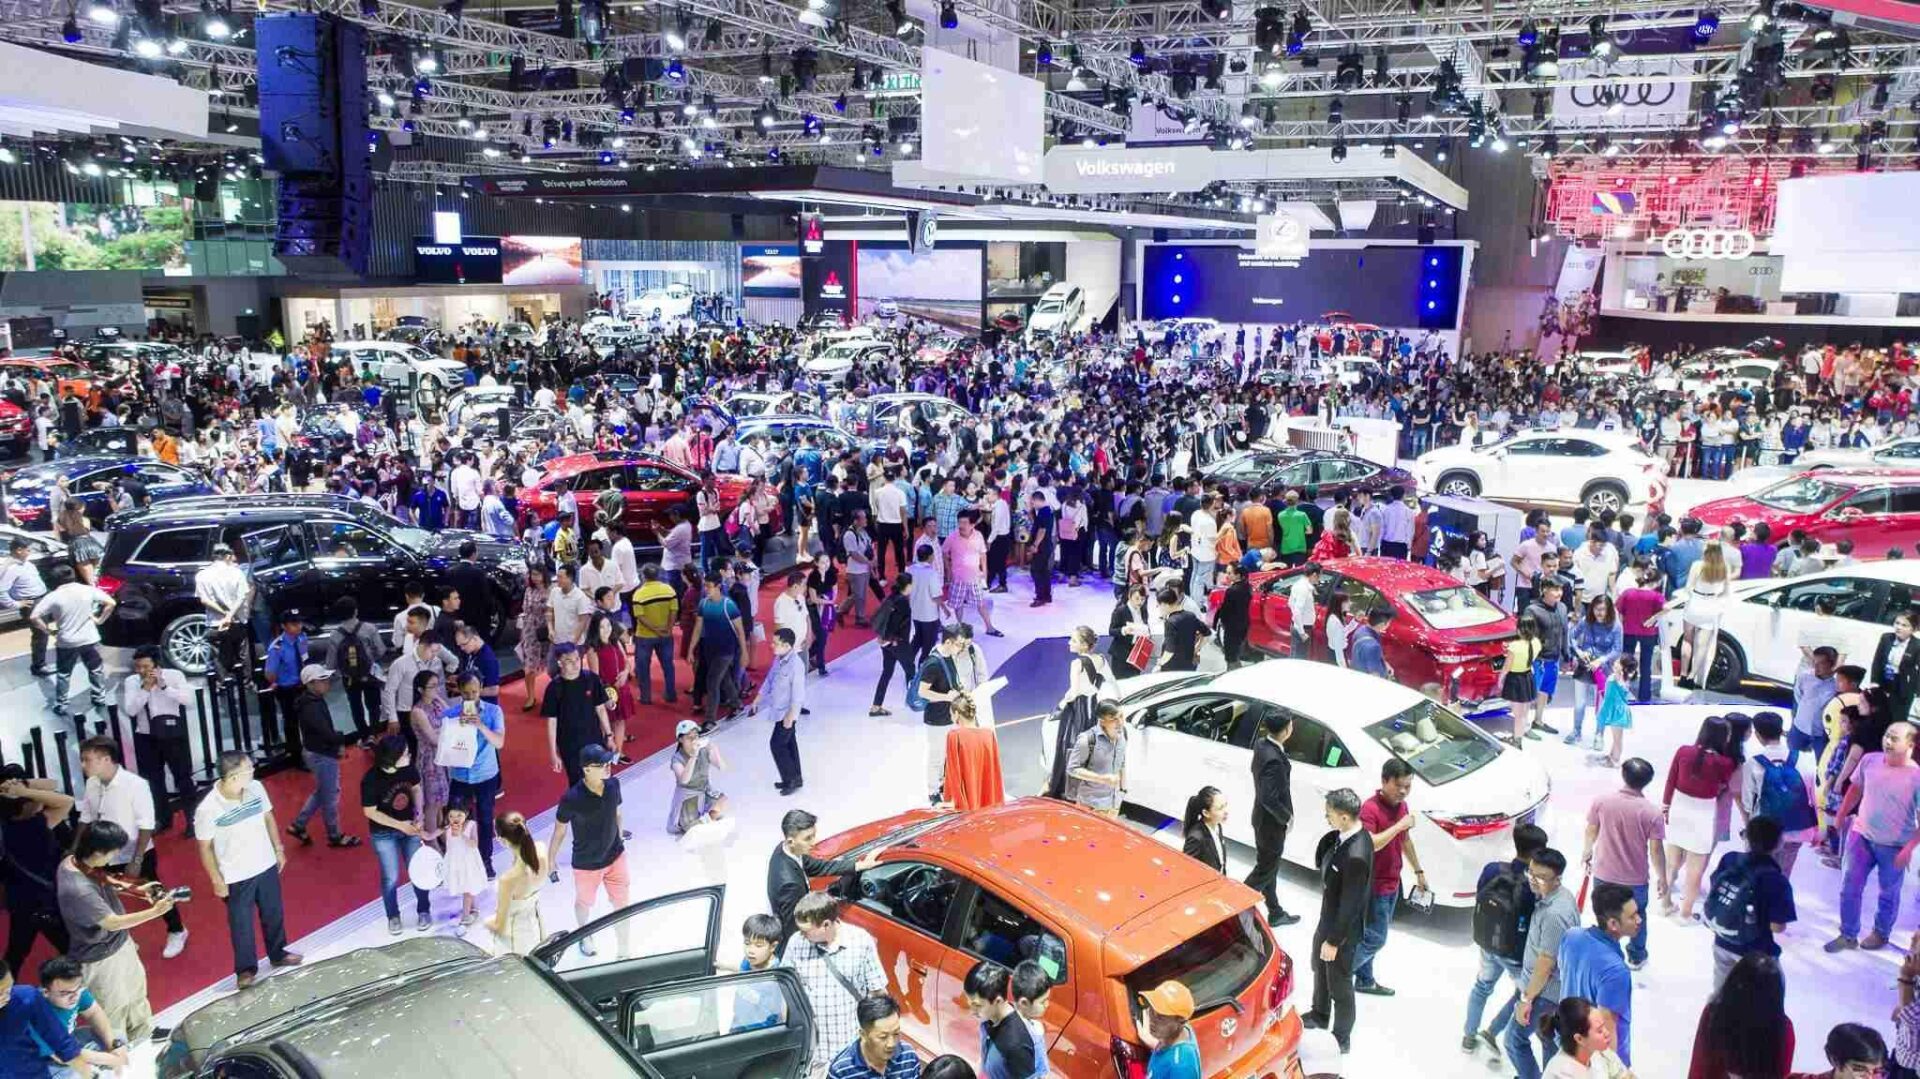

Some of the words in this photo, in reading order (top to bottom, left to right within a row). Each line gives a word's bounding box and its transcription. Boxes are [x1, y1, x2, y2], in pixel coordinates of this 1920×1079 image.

[1076, 160, 1175, 178] Volkswagen
[416, 247, 452, 256] VOLVO
[462, 247, 498, 256] VOLVO
